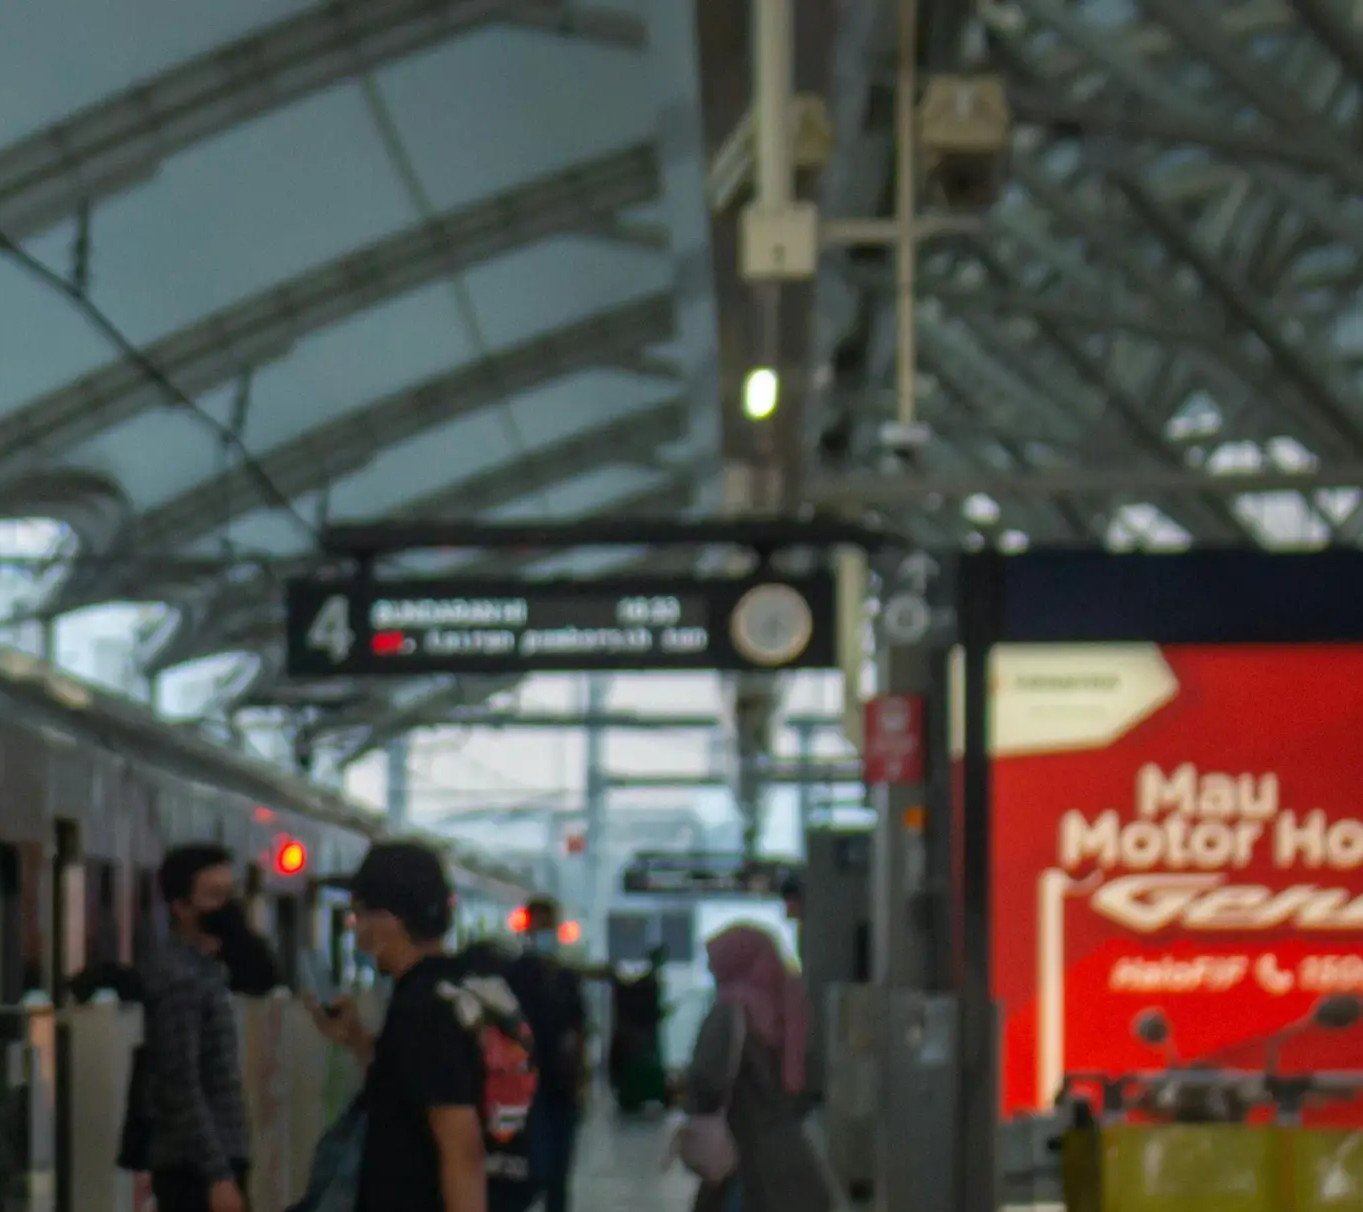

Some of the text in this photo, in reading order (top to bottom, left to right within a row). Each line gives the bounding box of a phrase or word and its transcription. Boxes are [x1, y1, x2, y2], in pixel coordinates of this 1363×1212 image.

[308, 593, 355, 667] 4
[1136, 761, 1279, 820] Mau
[1058, 808, 1265, 870] Motor
